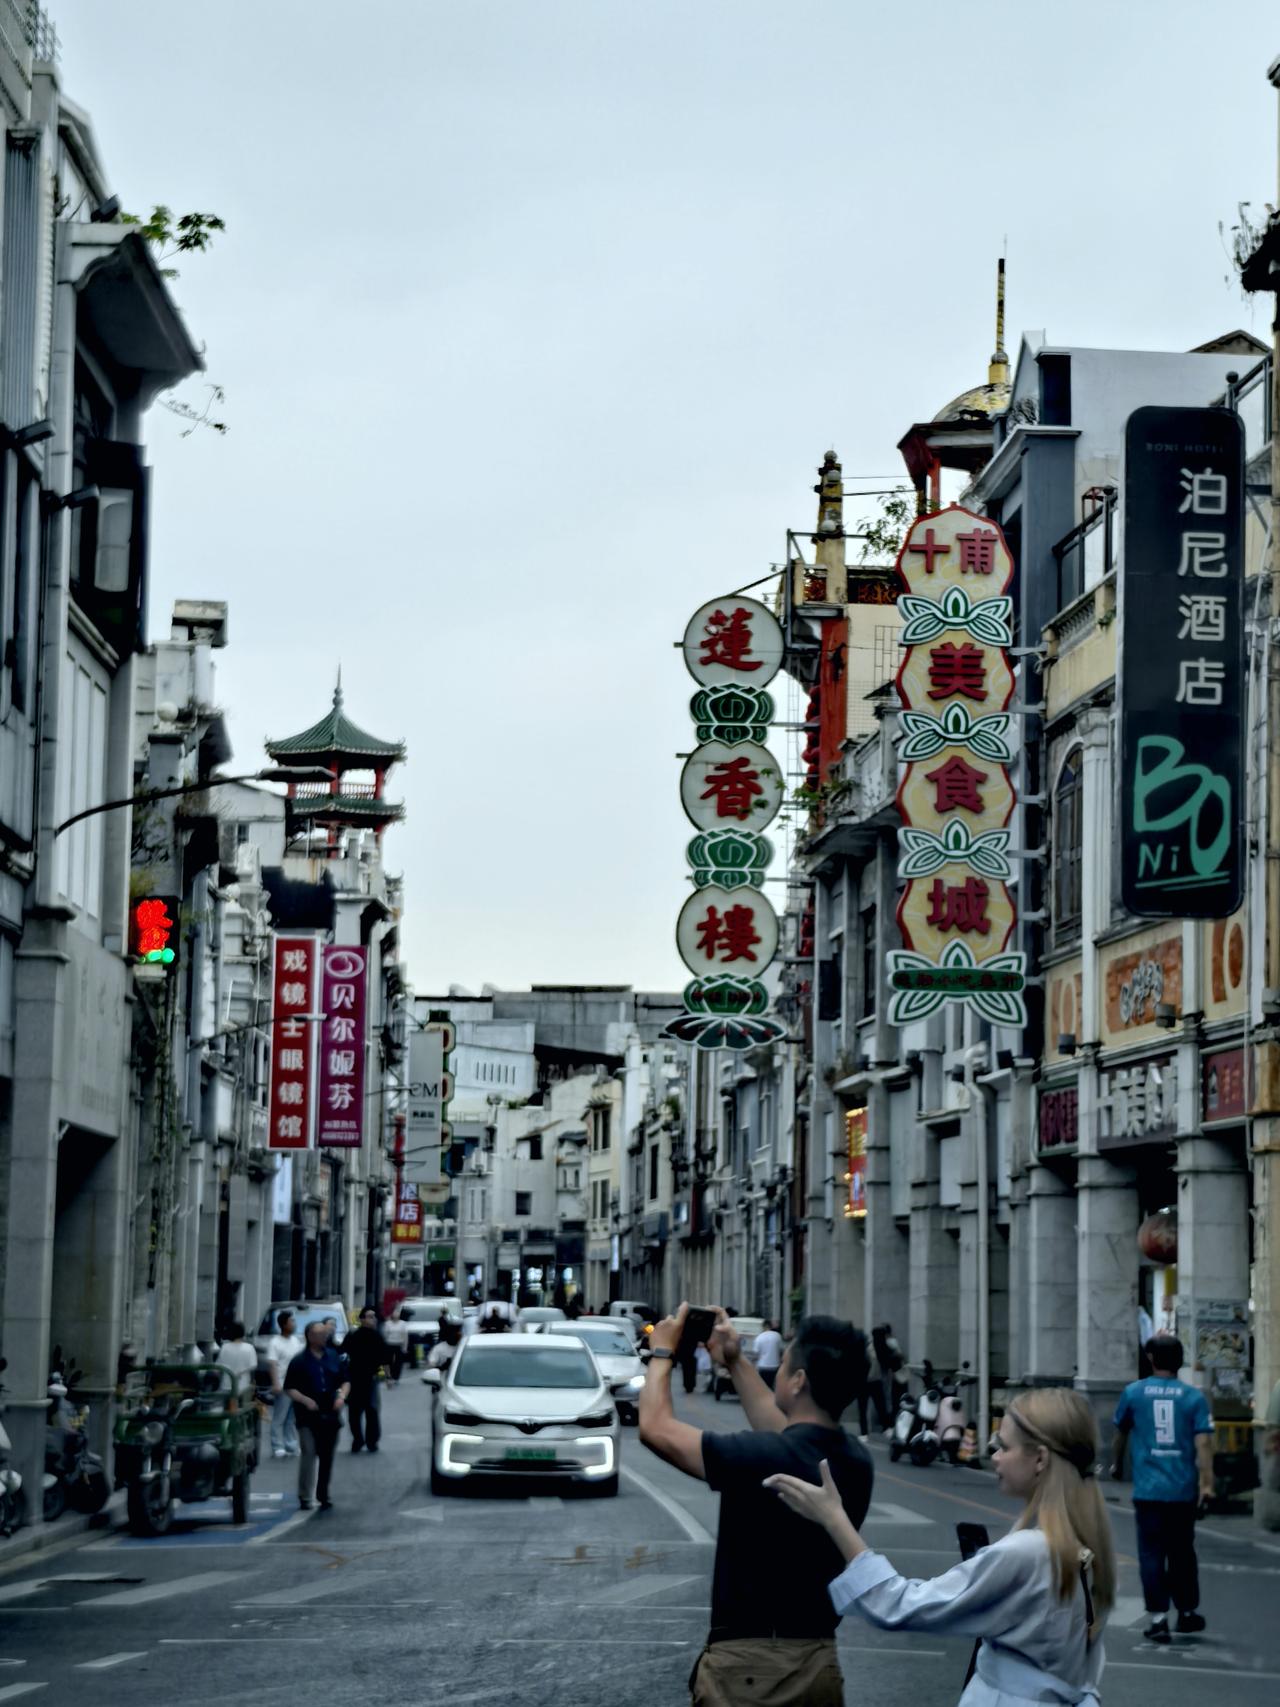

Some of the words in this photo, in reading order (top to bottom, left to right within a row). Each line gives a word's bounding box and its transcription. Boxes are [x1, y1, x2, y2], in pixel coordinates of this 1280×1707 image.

[908, 527, 999, 575] 十甫
[1175, 466, 1229, 706] 泊尼酒店
[697, 607, 764, 962] 蓮香樓
[924, 641, 992, 935] 美食城
[327, 983, 356, 1111] 贝尔妮芬
[1153, 1399, 1176, 1444] 9
